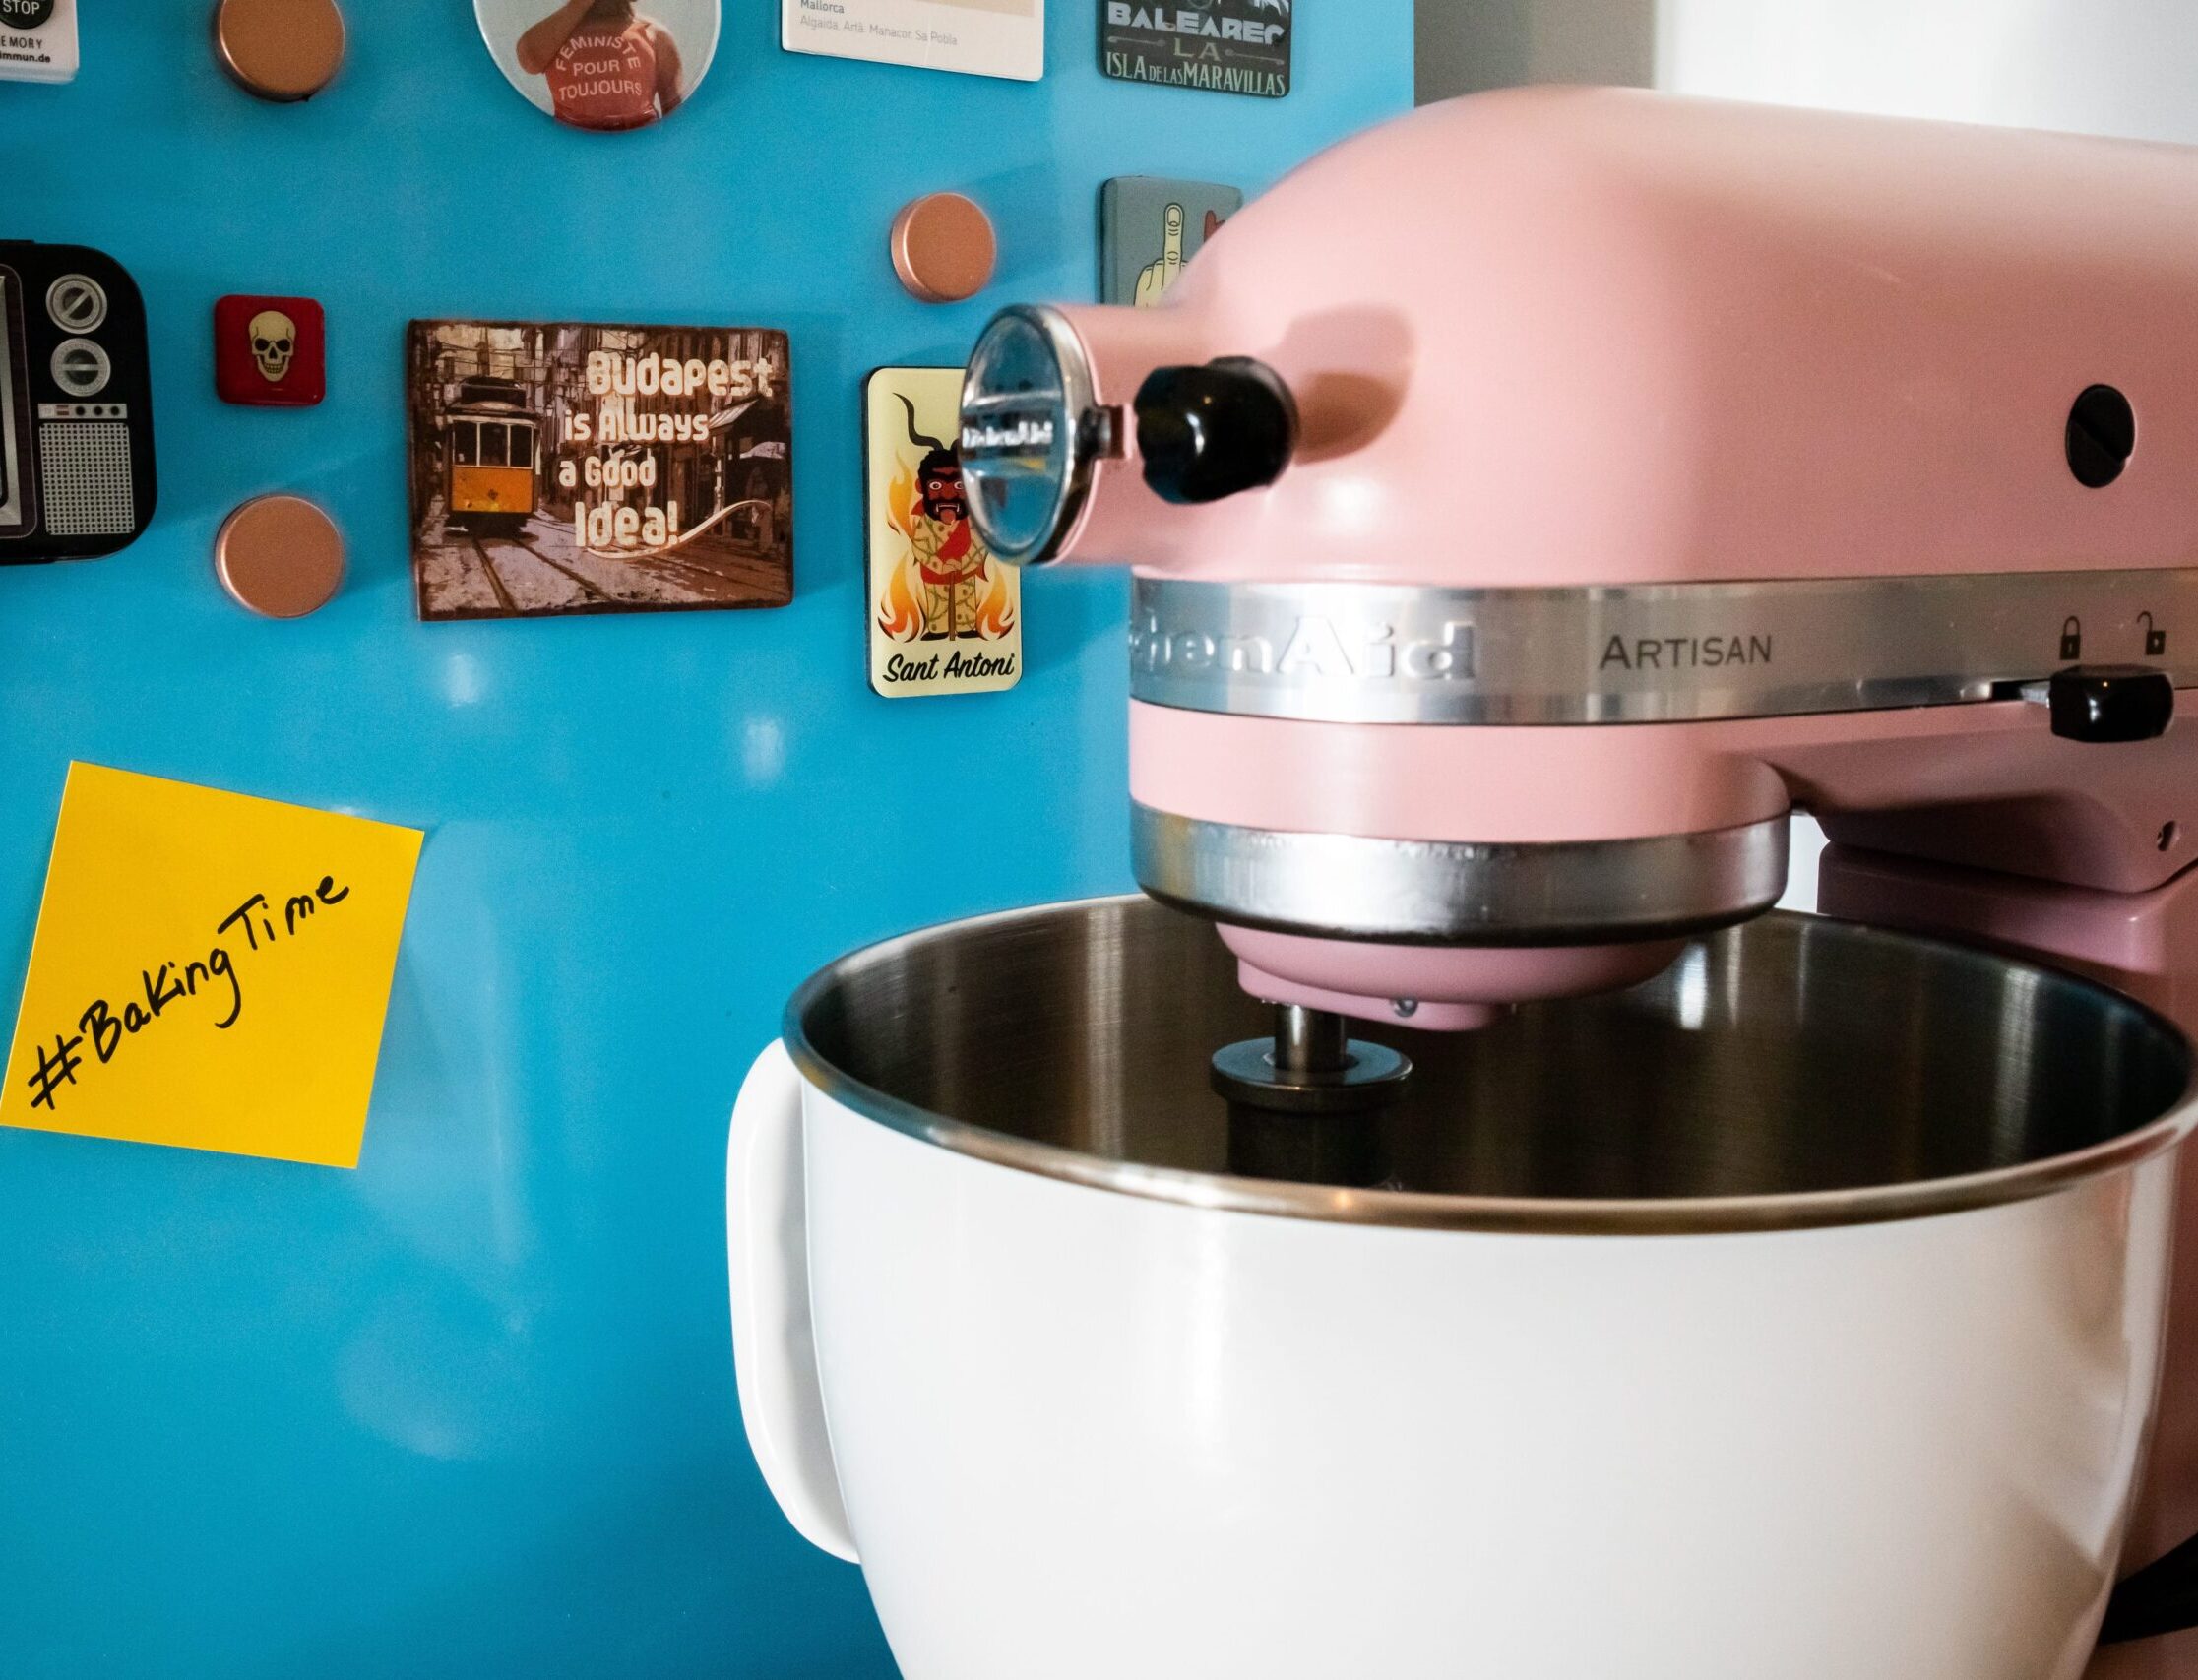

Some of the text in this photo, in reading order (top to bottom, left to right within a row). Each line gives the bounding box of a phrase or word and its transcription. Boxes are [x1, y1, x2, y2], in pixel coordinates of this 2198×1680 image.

[3, 0, 40, 15] STOP
[800, 0, 845, 14] Mallorca
[555, 36, 640, 71] FEMINISTE
[915, 30, 928, 41] Sa
[930, 31, 958, 45] Pobla
[573, 60, 620, 77] POUR
[1106, 52, 1286, 95] ISLA DE LAS MARAVILLAS
[558, 80, 642, 100] TOUJOURS
[587, 350, 773, 396] Budapest
[564, 408, 709, 442] is Always
[558, 449, 657, 488] a Good
[575, 500, 679, 547] Idea!
[882, 650, 1016, 682] Sant Antoni
[1600, 635, 1772, 670] ARTISAN
